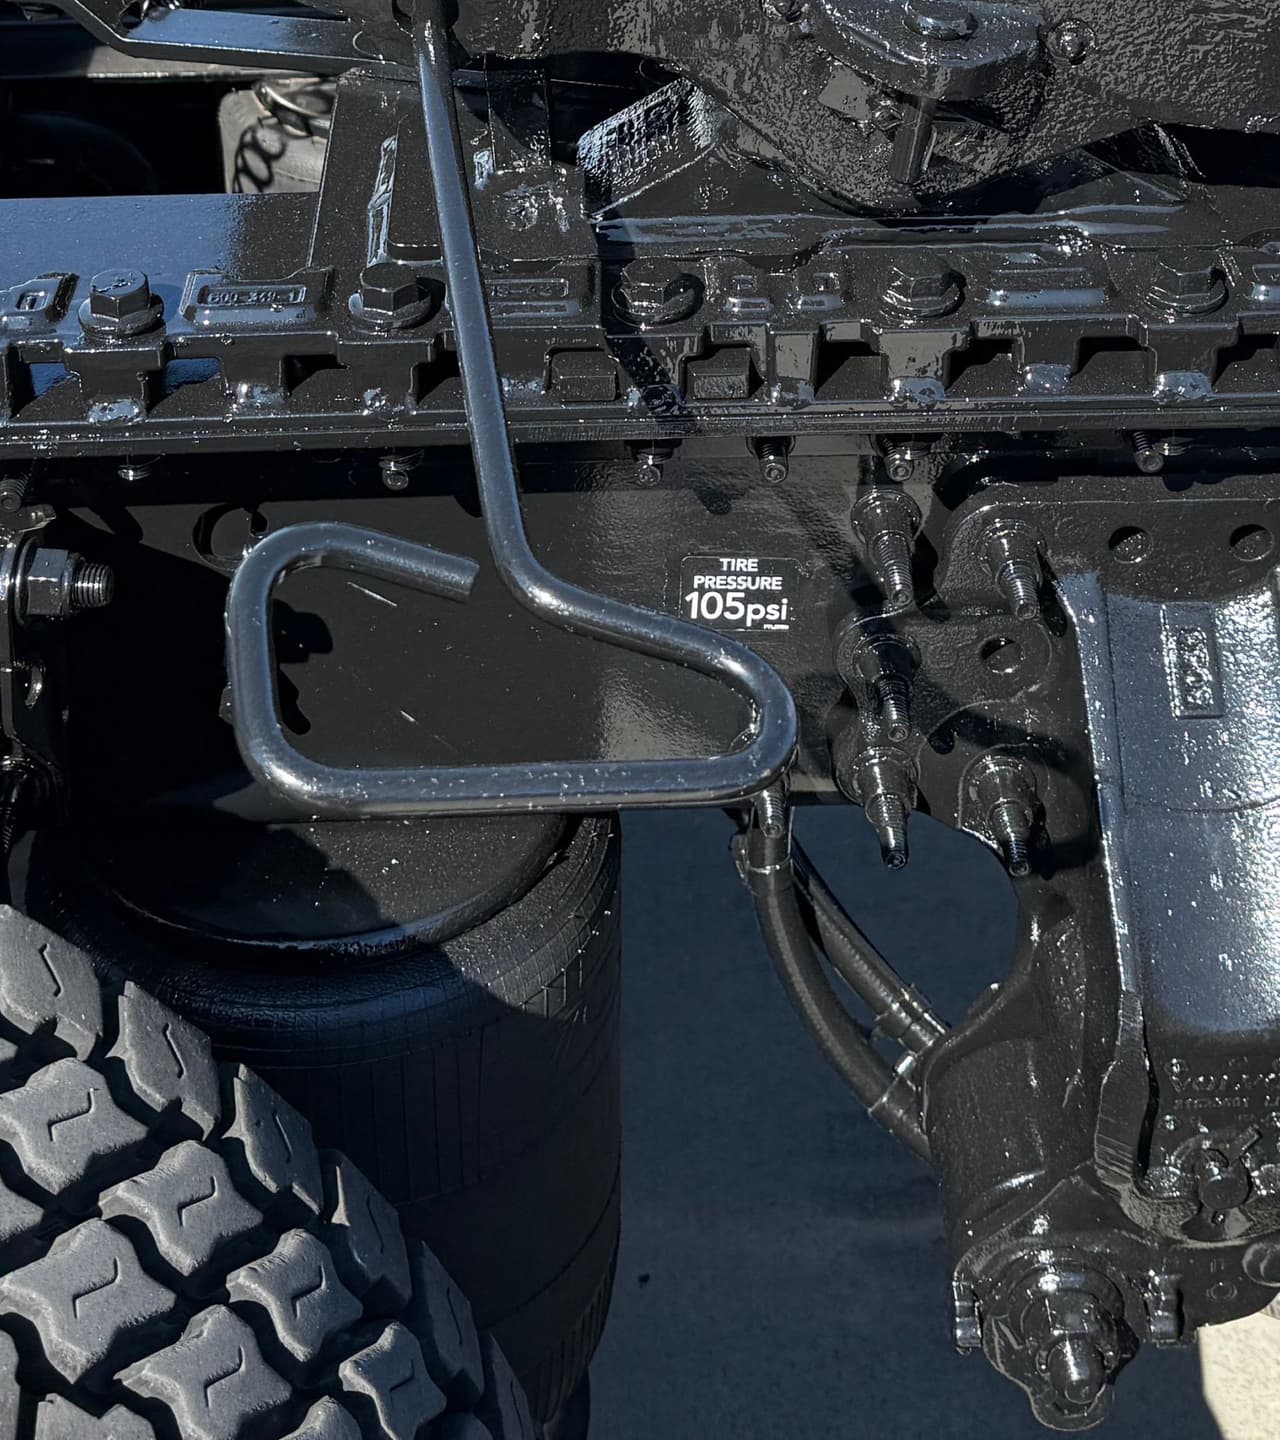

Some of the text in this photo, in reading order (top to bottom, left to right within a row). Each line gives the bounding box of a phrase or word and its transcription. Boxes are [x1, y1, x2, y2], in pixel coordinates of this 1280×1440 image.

[720, 558, 759, 572] TIRE
[693, 575, 783, 590] PRESSURE
[685, 591, 788, 627] 105psi
